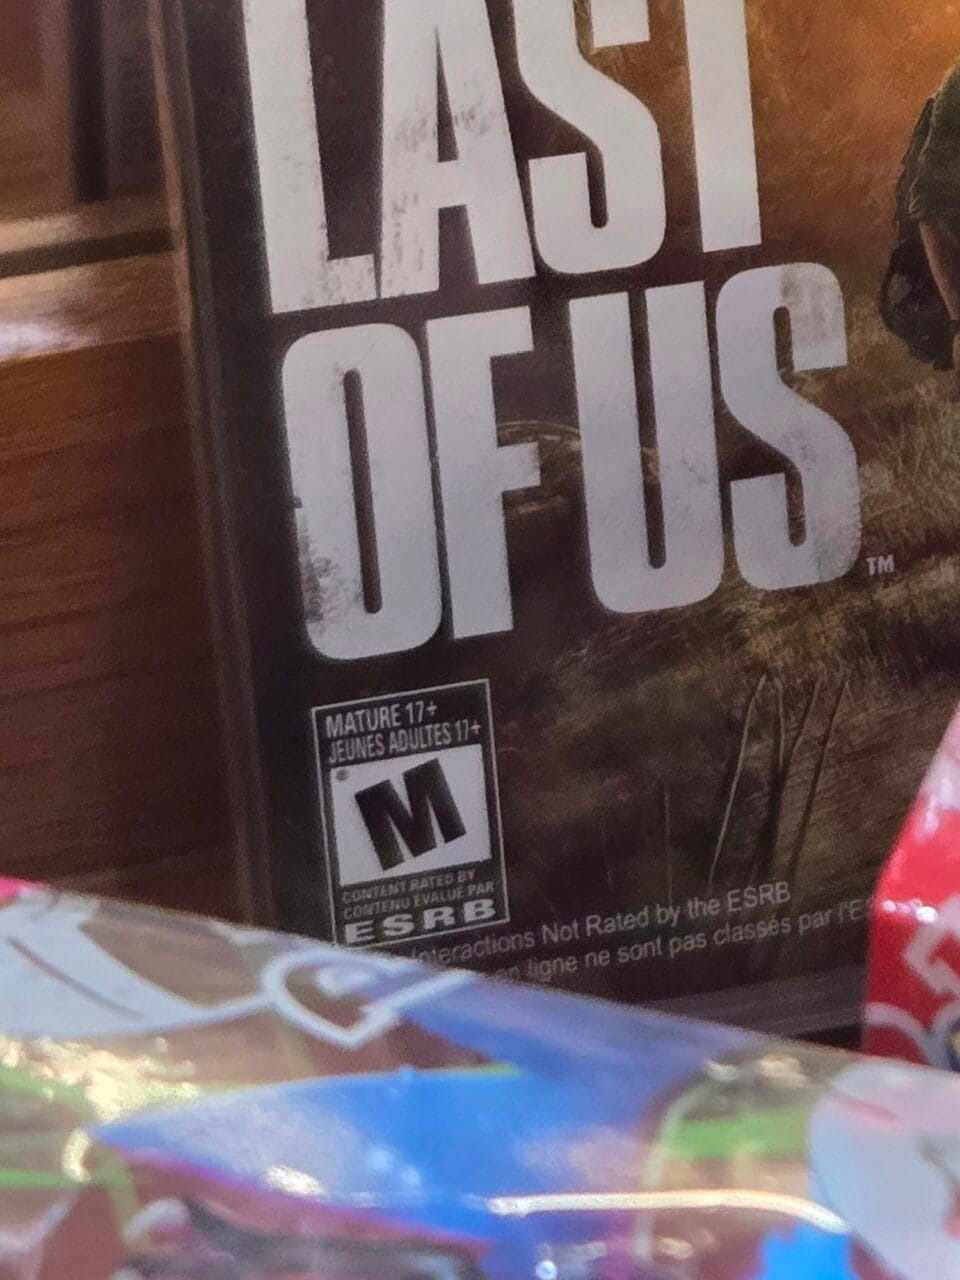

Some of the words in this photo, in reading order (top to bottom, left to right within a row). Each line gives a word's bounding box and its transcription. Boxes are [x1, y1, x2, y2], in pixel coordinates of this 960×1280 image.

[280, 305, 541, 662] OF
[567, 261, 862, 614] US
[325, 703, 401, 739] MATURE
[405, 700, 439, 725] 17+
[328, 731, 386, 765] JEUNES
[388, 721, 452, 754] ADULTES
[455, 718, 482, 742] 17+
[354, 757, 467, 872] M
[344, 897, 497, 945] ESRB
[541, 920, 580, 944] Not
[585, 905, 650, 937] Rated
[656, 902, 681, 928] by
[687, 895, 721, 920] the
[727, 880, 792, 914] ESRB
[585, 948, 611, 968] ne
[617, 936, 663, 964] sont
[669, 931, 708, 959] pas
[799, 908, 832, 932] par
